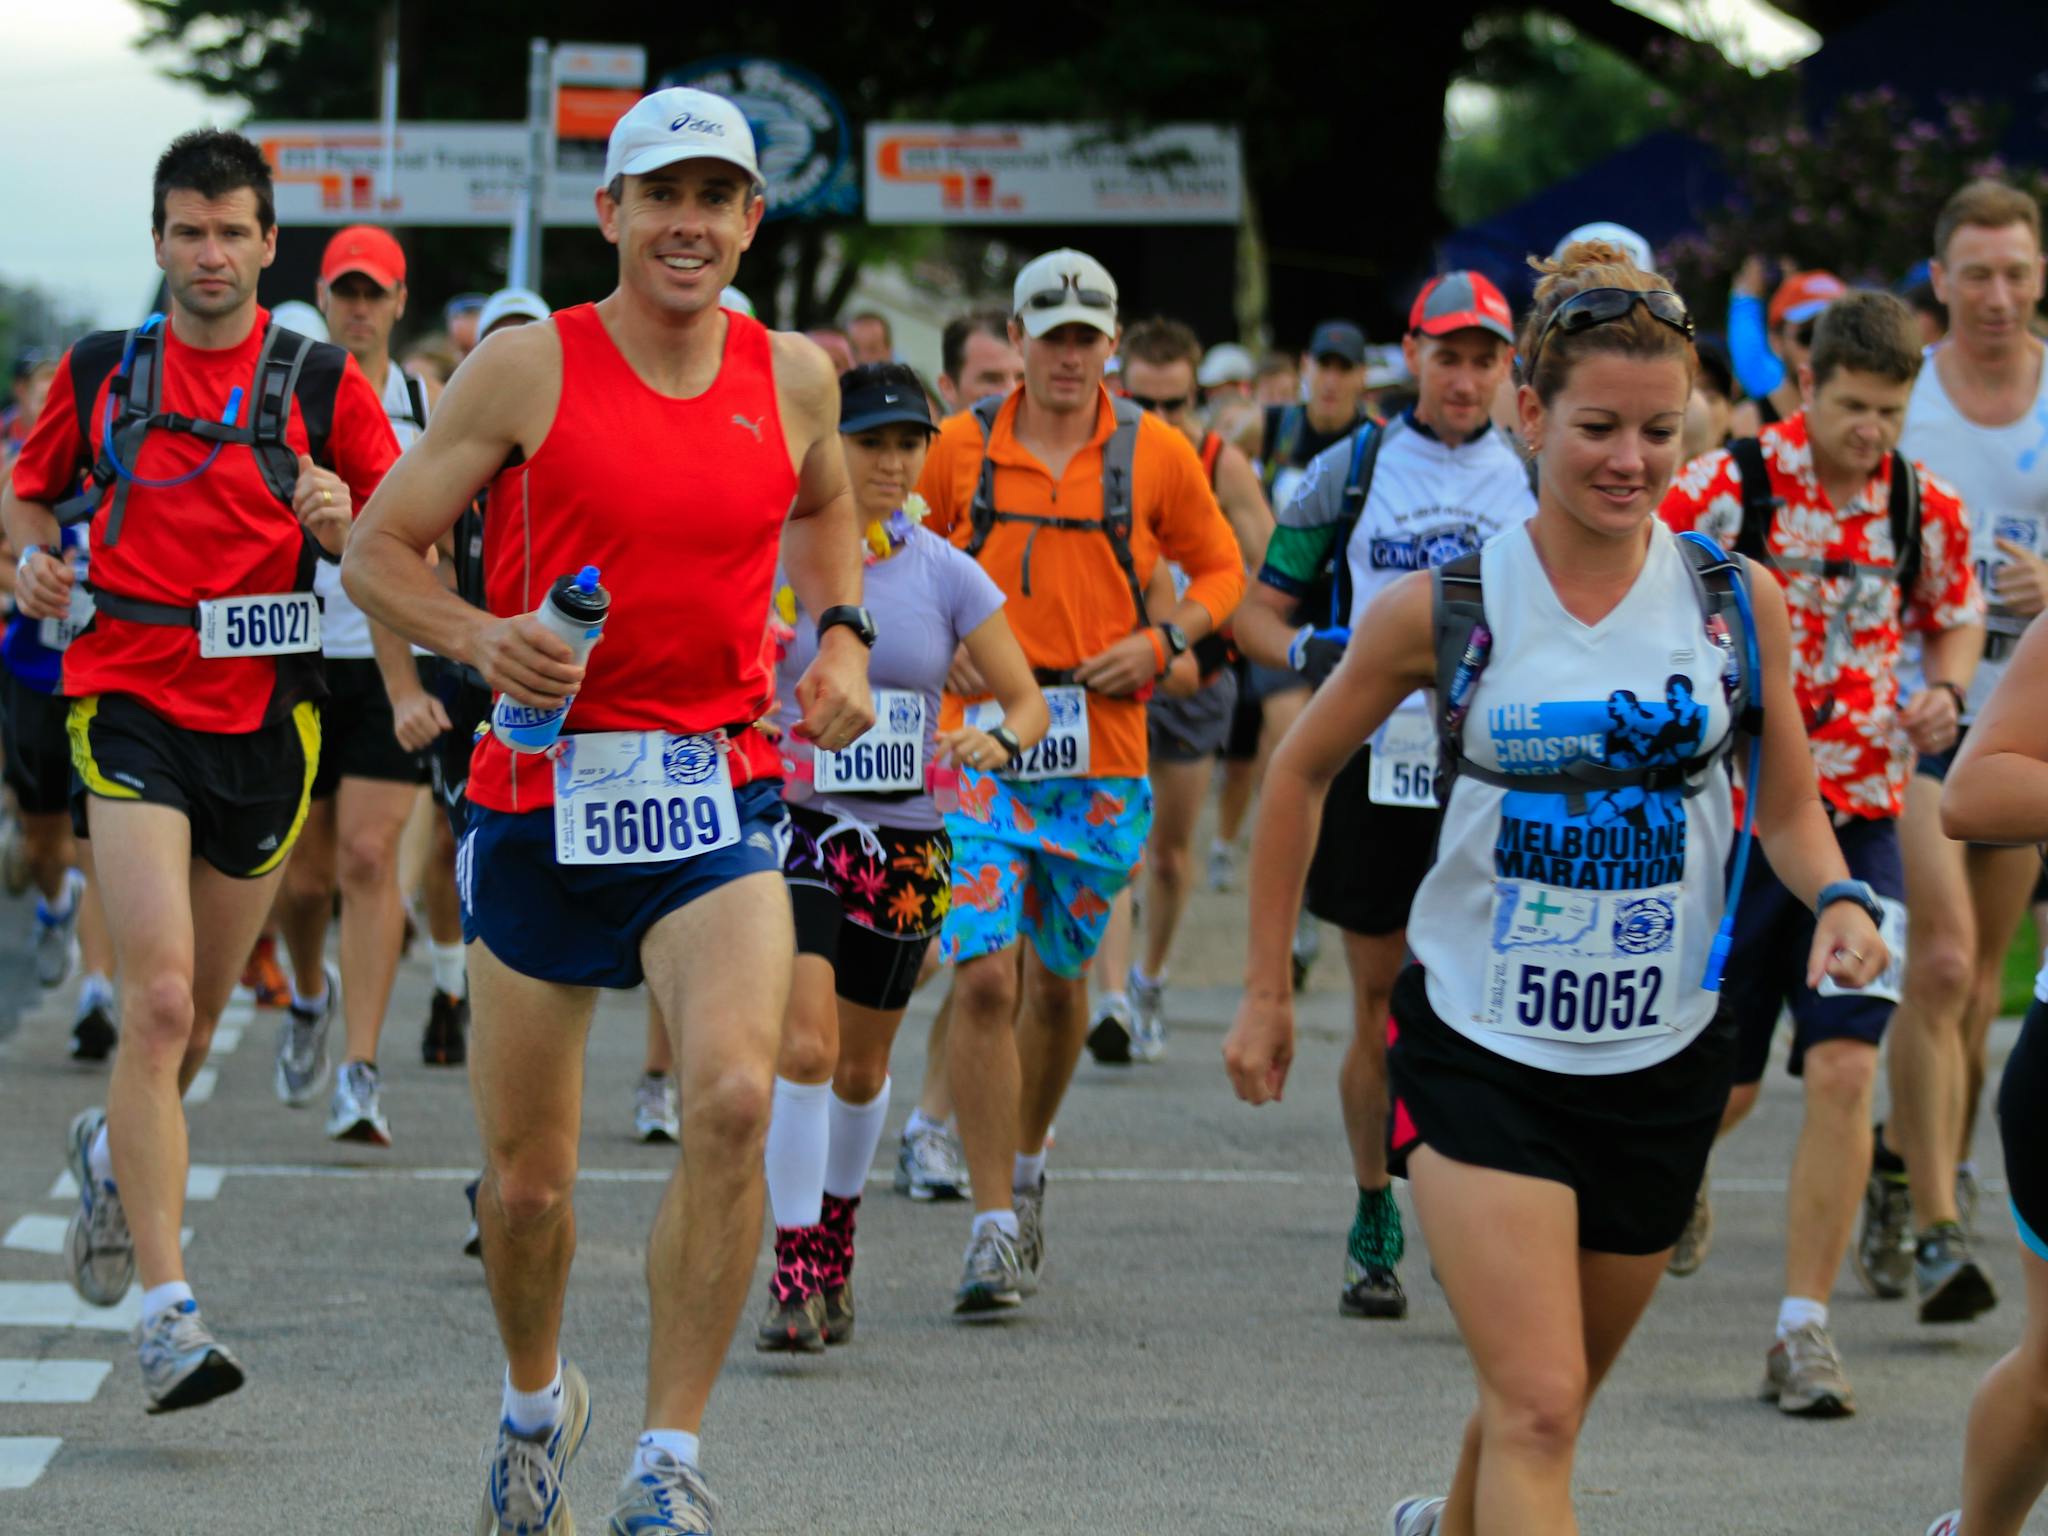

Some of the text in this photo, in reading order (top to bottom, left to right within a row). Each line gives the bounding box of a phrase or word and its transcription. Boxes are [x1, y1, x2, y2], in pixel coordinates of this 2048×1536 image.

[226, 601, 310, 649] 56027
[1487, 701, 1541, 731] THE
[834, 741, 914, 782] 56009
[1492, 734, 1604, 763] CROSBIE
[1393, 763, 1439, 800] 56
[584, 795, 721, 857] 56089
[1501, 815, 1686, 861] MELBOURNE
[1495, 847, 1685, 891] MARATHON
[1517, 963, 1662, 1033] 56052
